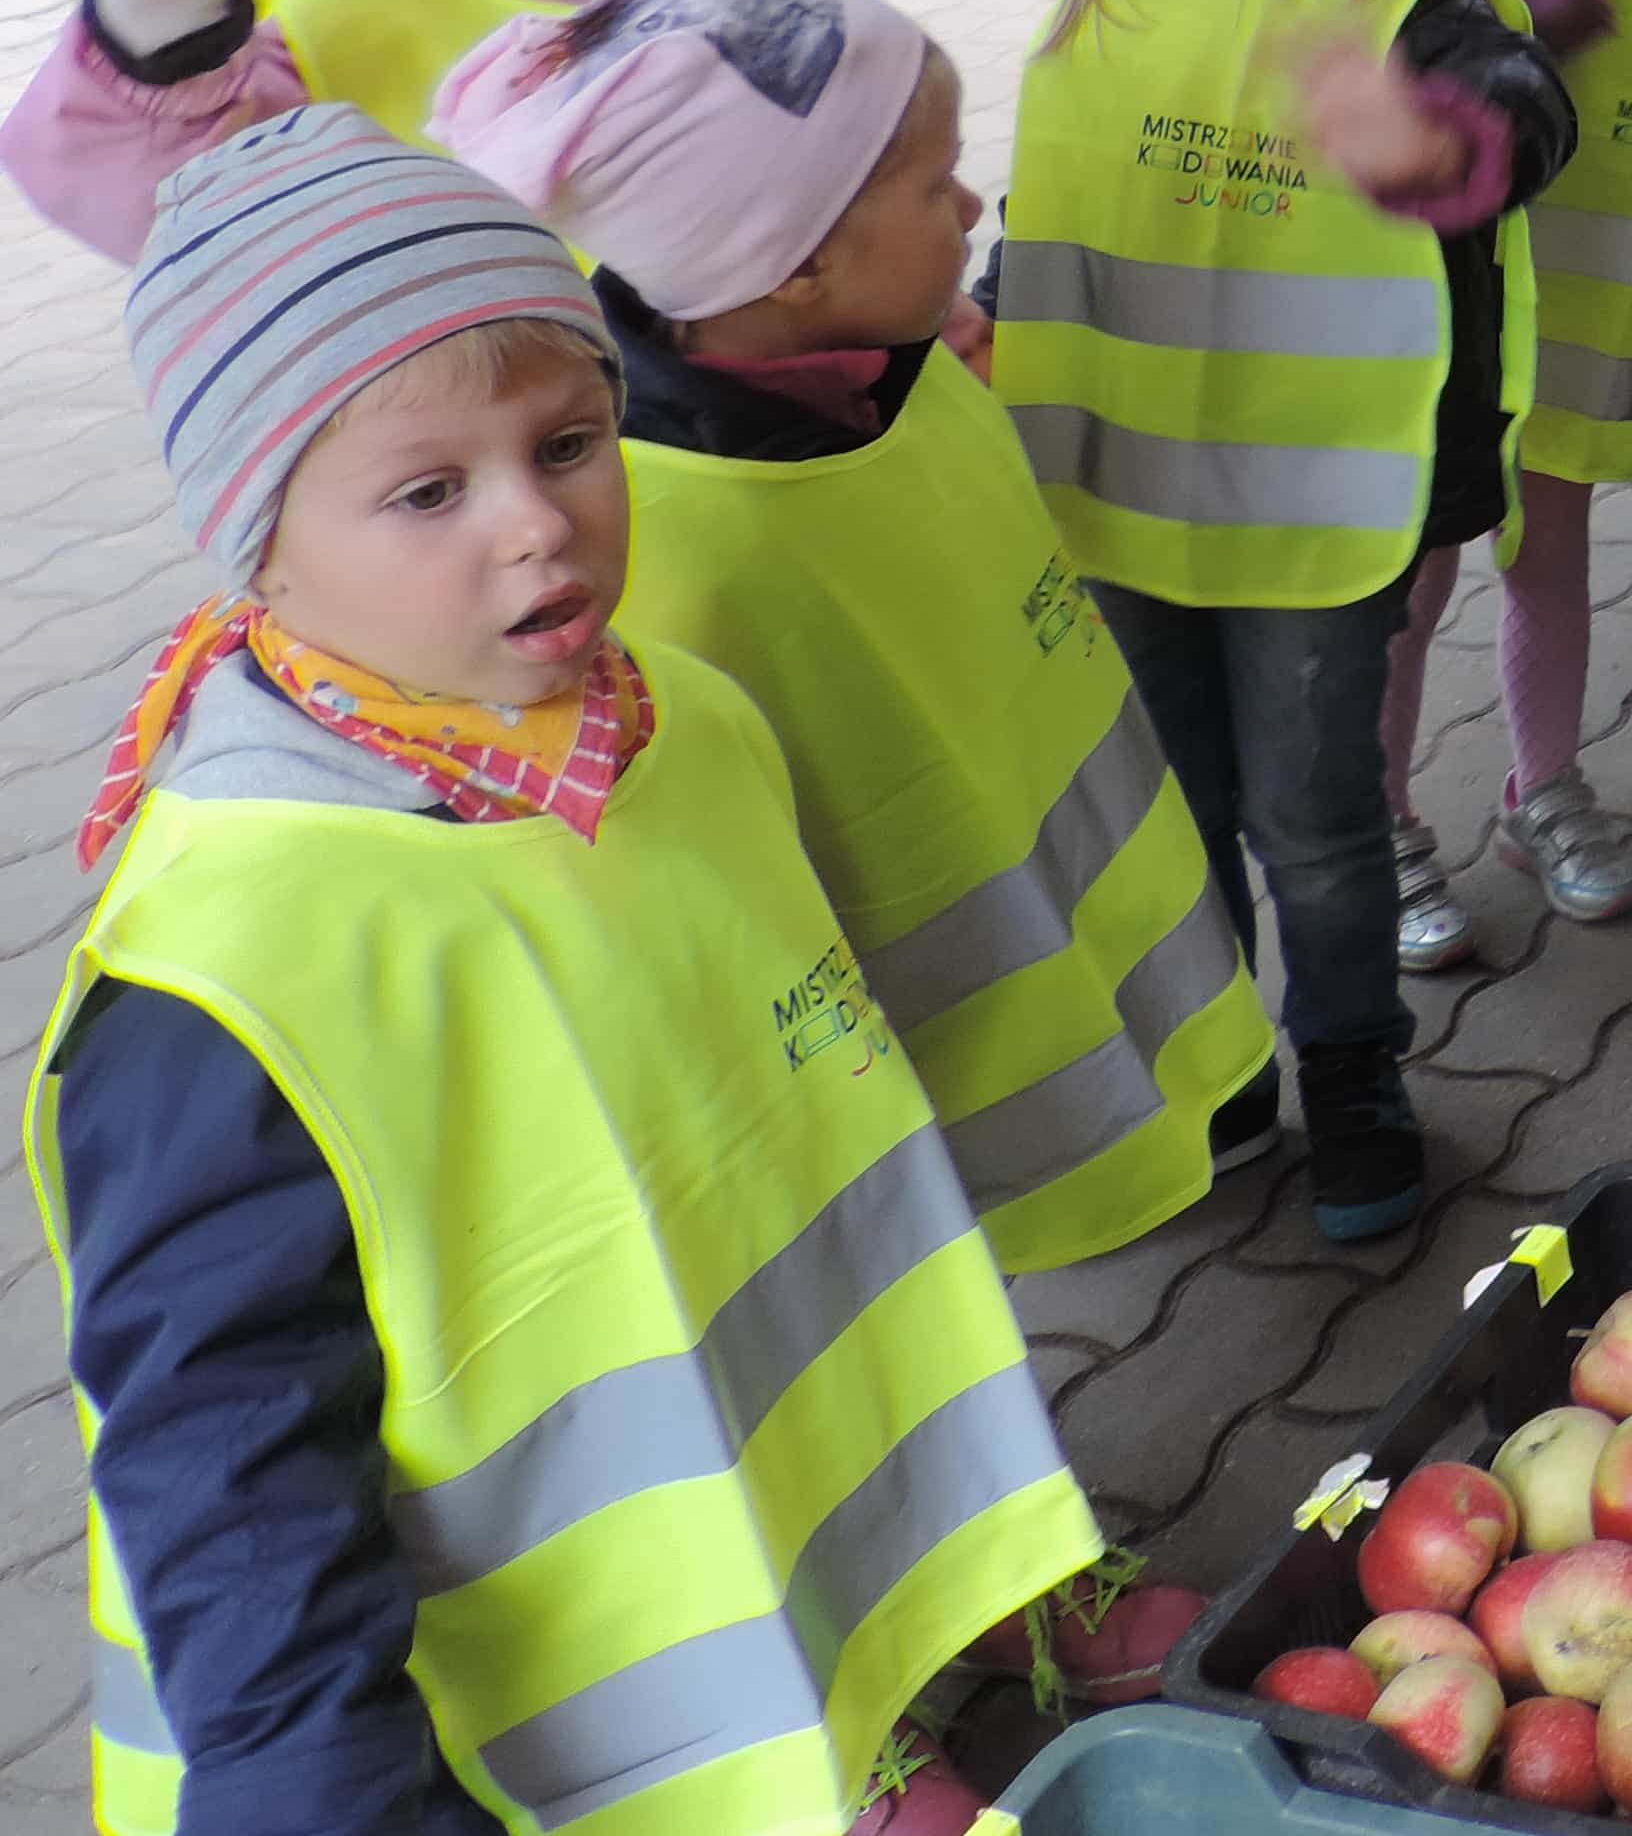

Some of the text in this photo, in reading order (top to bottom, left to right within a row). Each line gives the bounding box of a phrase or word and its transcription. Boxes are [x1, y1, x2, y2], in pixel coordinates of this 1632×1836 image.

[1143, 113, 1296, 160] MISTRZOWIE
[1137, 143, 1307, 191] KODOWANIA
[1175, 182, 1293, 219] JUNIOR
